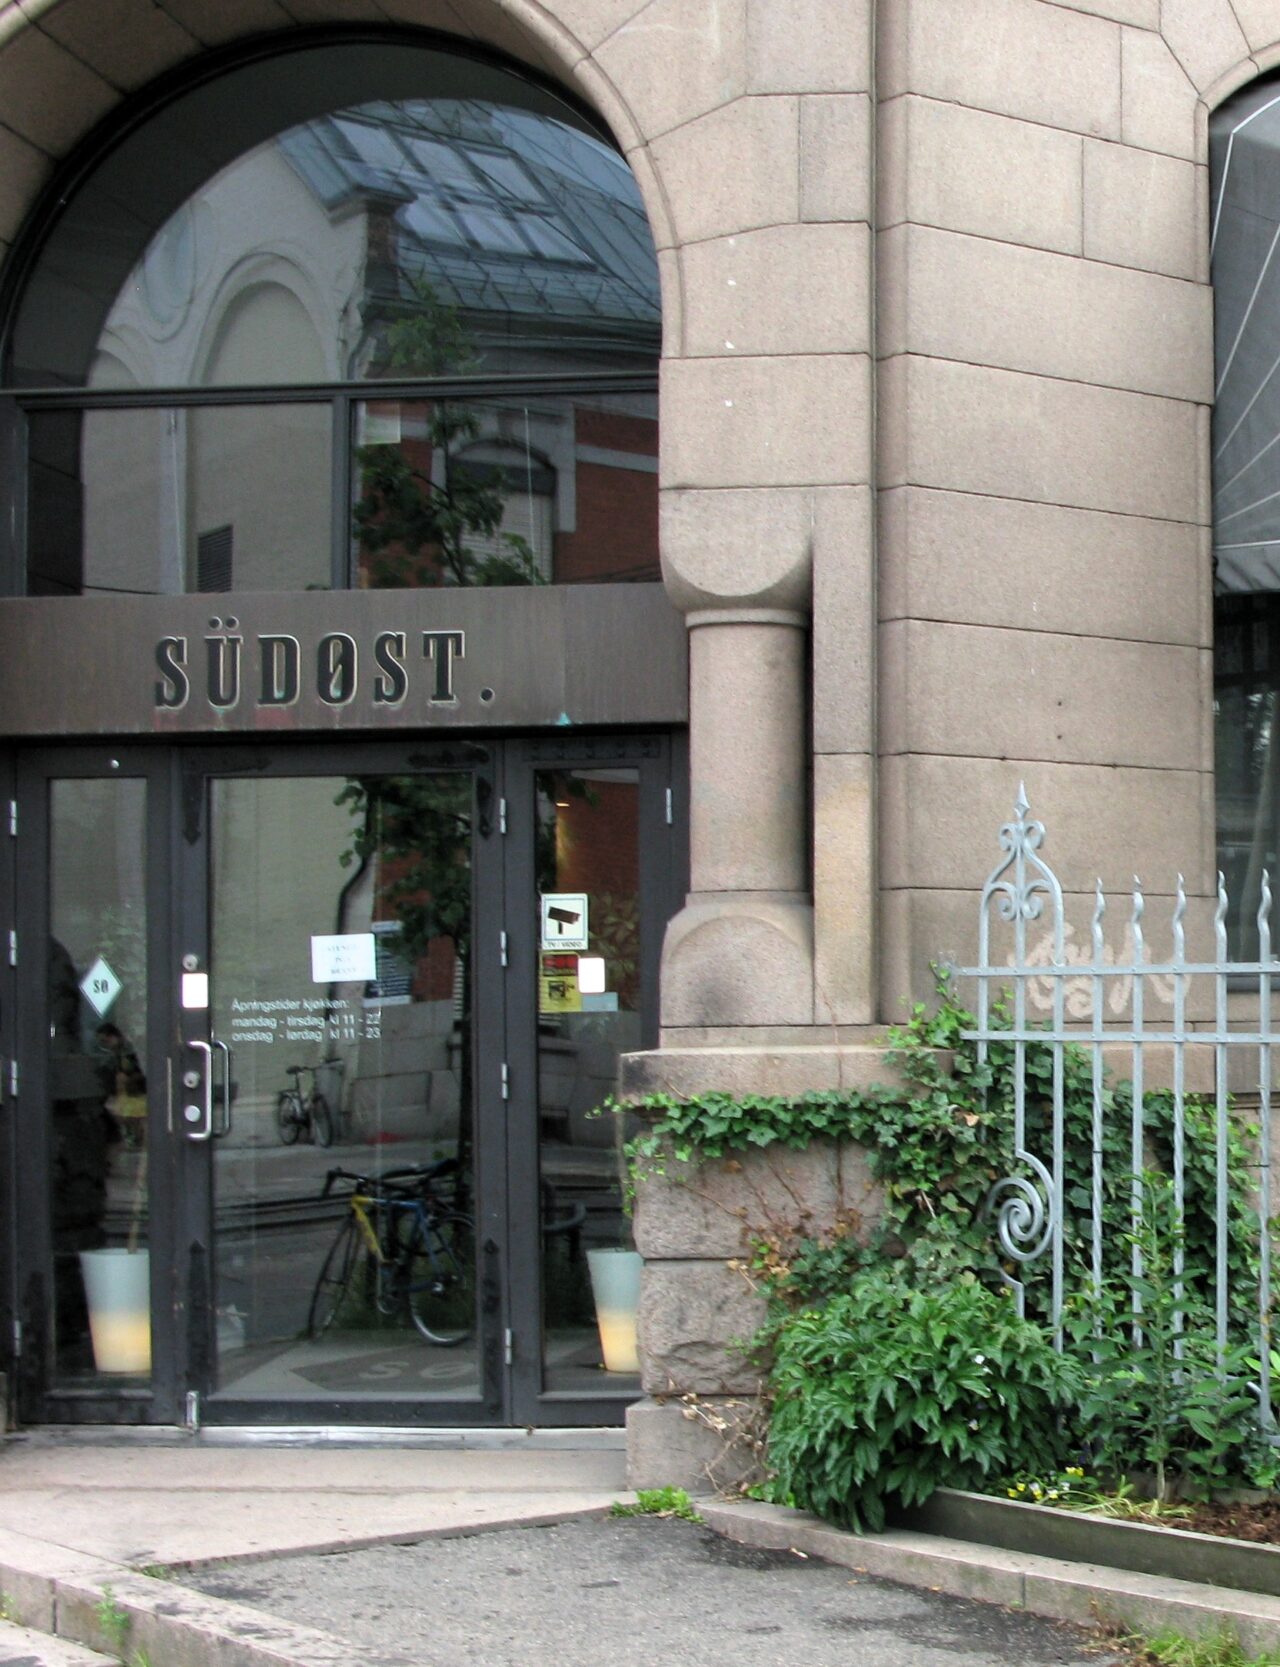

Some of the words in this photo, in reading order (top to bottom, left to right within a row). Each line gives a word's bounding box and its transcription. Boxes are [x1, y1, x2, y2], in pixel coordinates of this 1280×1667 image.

[231, 1016, 277, 1029] mandag
[286, 1014, 325, 1029] tirsdag
[329, 1014, 340, 1025] kl
[343, 1014, 355, 1025] 11
[231, 1030, 273, 1043] onsdag
[286, 1029, 323, 1043] lørdag
[329, 1028, 340, 1039] kl
[343, 1028, 355, 1039] 11
[365, 1027, 381, 1039] 23
